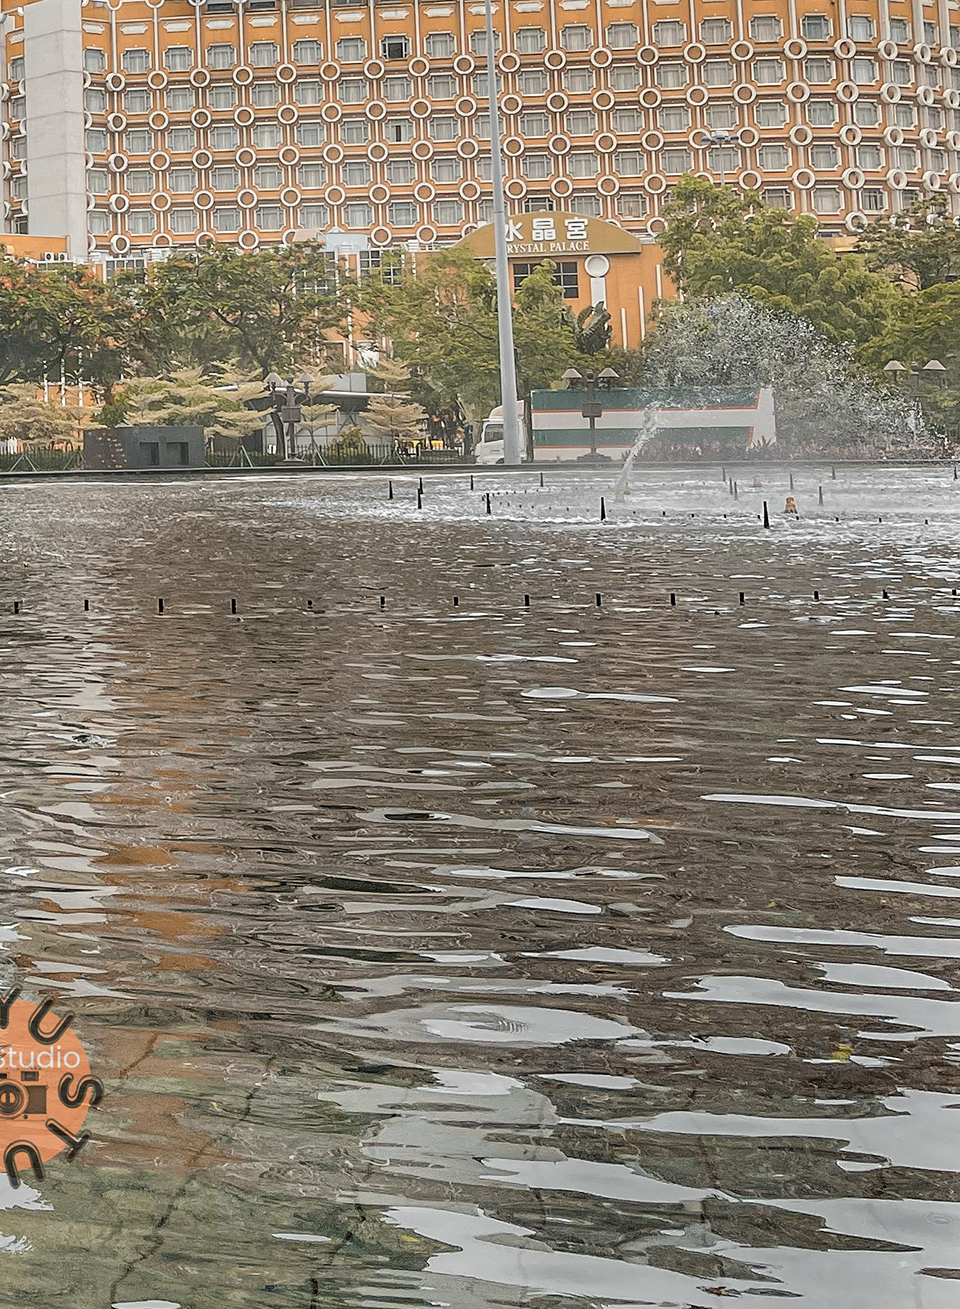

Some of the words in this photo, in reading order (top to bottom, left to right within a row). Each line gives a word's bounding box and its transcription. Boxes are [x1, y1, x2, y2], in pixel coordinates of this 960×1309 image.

[505, 217, 589, 242] 水晶宮
[506, 242, 547, 254] RYSTAL
[549, 241, 590, 252] PALACE
